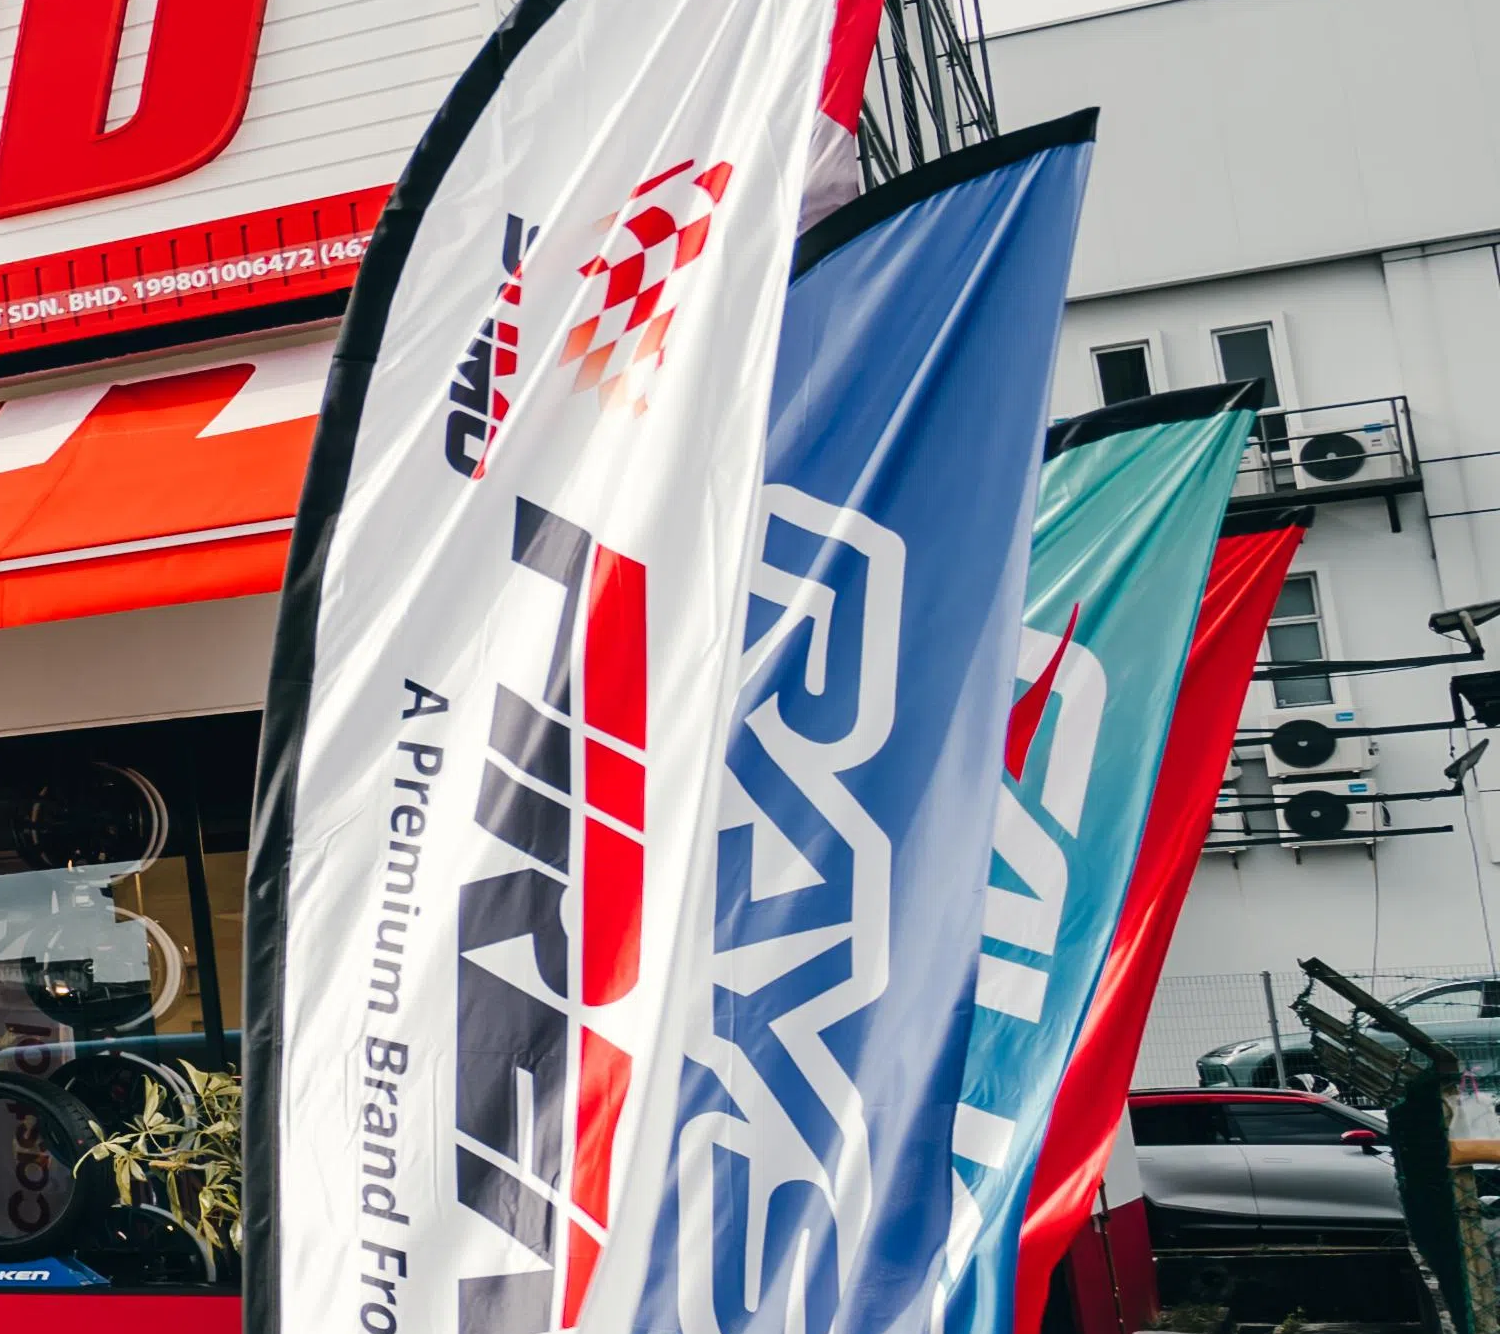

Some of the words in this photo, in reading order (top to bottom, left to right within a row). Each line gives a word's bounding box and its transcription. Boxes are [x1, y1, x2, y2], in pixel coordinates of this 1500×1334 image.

[7, 298, 65, 328] SDN.
[69, 286, 129, 315] BHD.
[132, 251, 316, 301] 199801006472
[401, 677, 450, 721] A
[368, 737, 448, 1015] Premium
[358, 1038, 411, 1228] Brand
